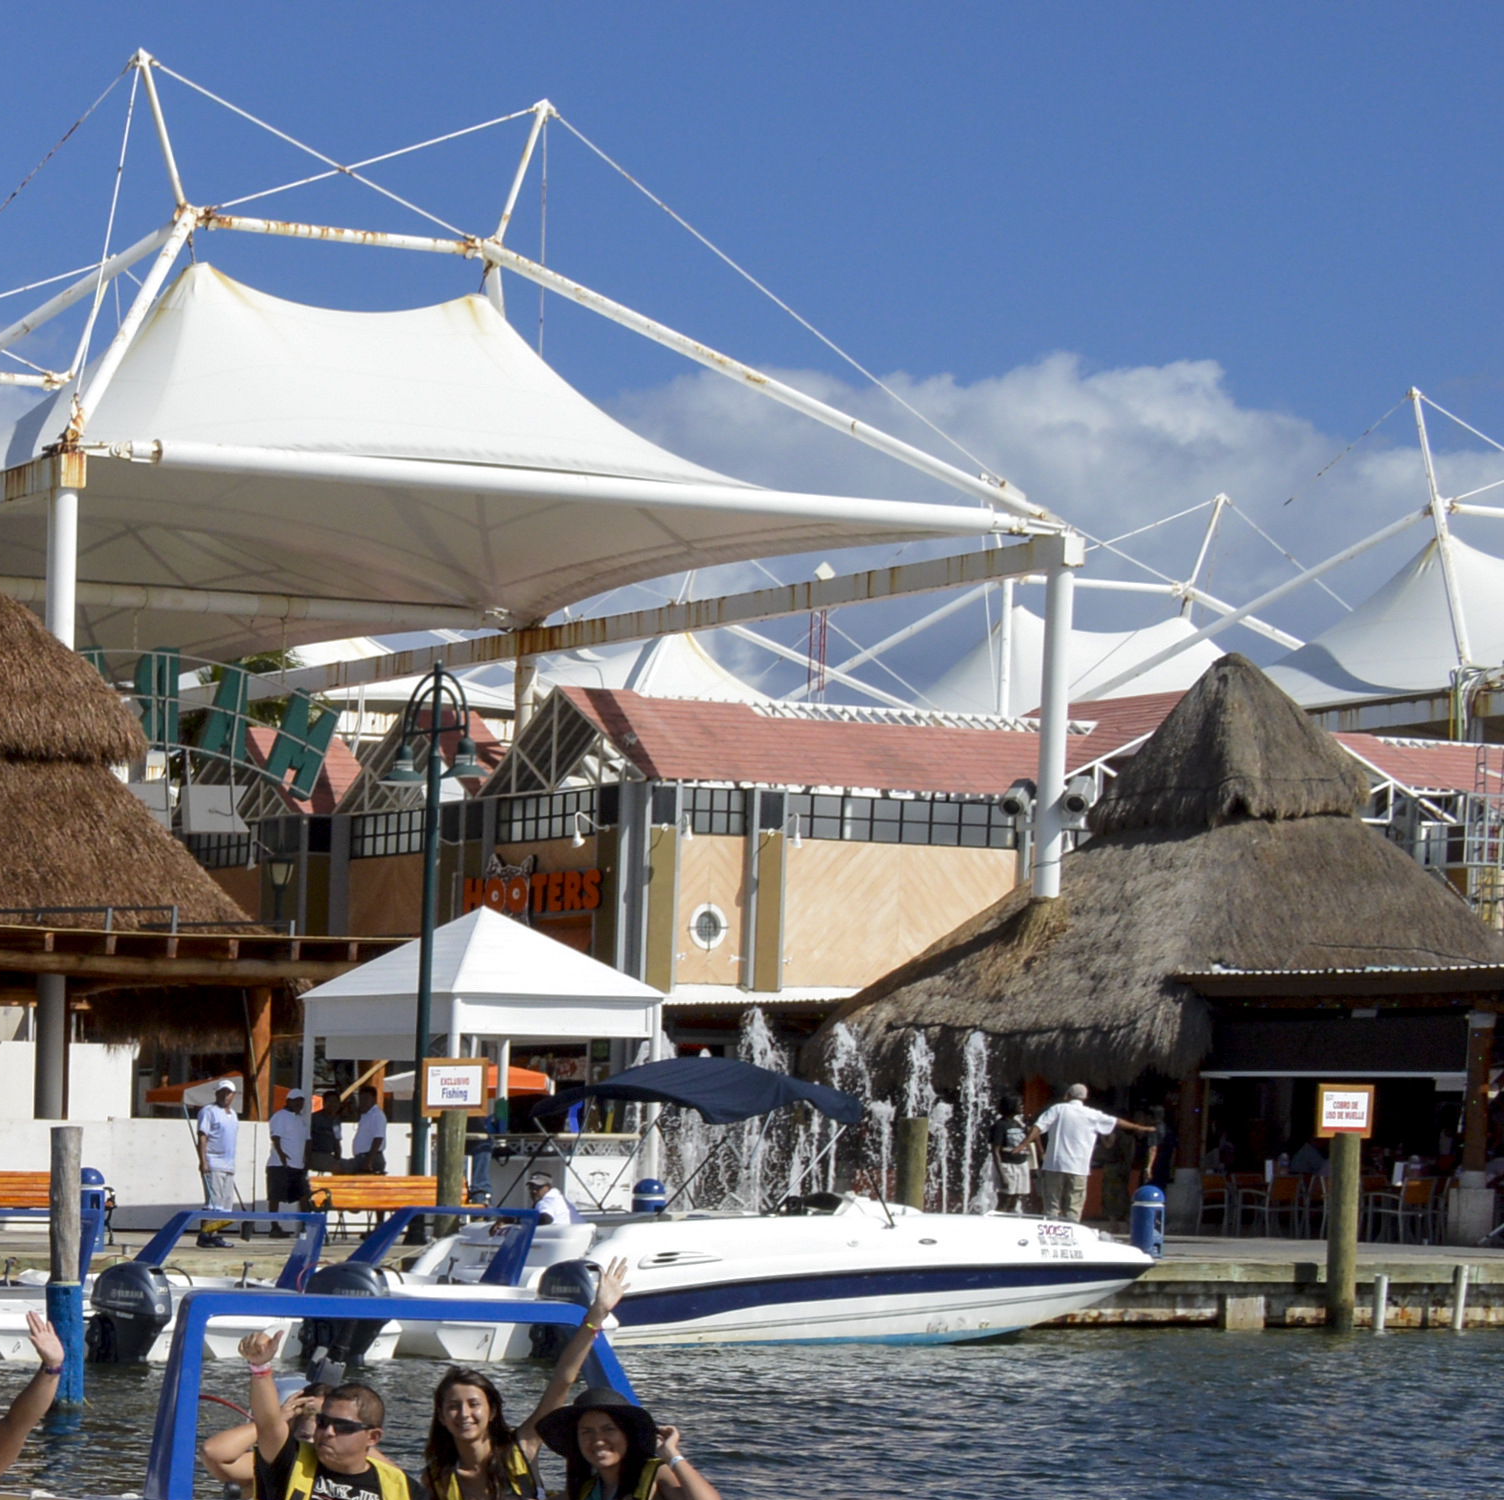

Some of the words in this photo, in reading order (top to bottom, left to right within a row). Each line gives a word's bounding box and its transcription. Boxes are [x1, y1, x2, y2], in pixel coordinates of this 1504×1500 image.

[463, 868, 601, 915] HOOTERS
[440, 1077, 470, 1086] EXCLUSIVO
[441, 1087, 468, 1102] Fishing
[1332, 1101, 1350, 1110] COBRO
[1351, 1101, 1359, 1110] DE
[1325, 1111, 1336, 1119] USO
[1337, 1111, 1344, 1119] DE
[1345, 1111, 1365, 1120] MUELLE
